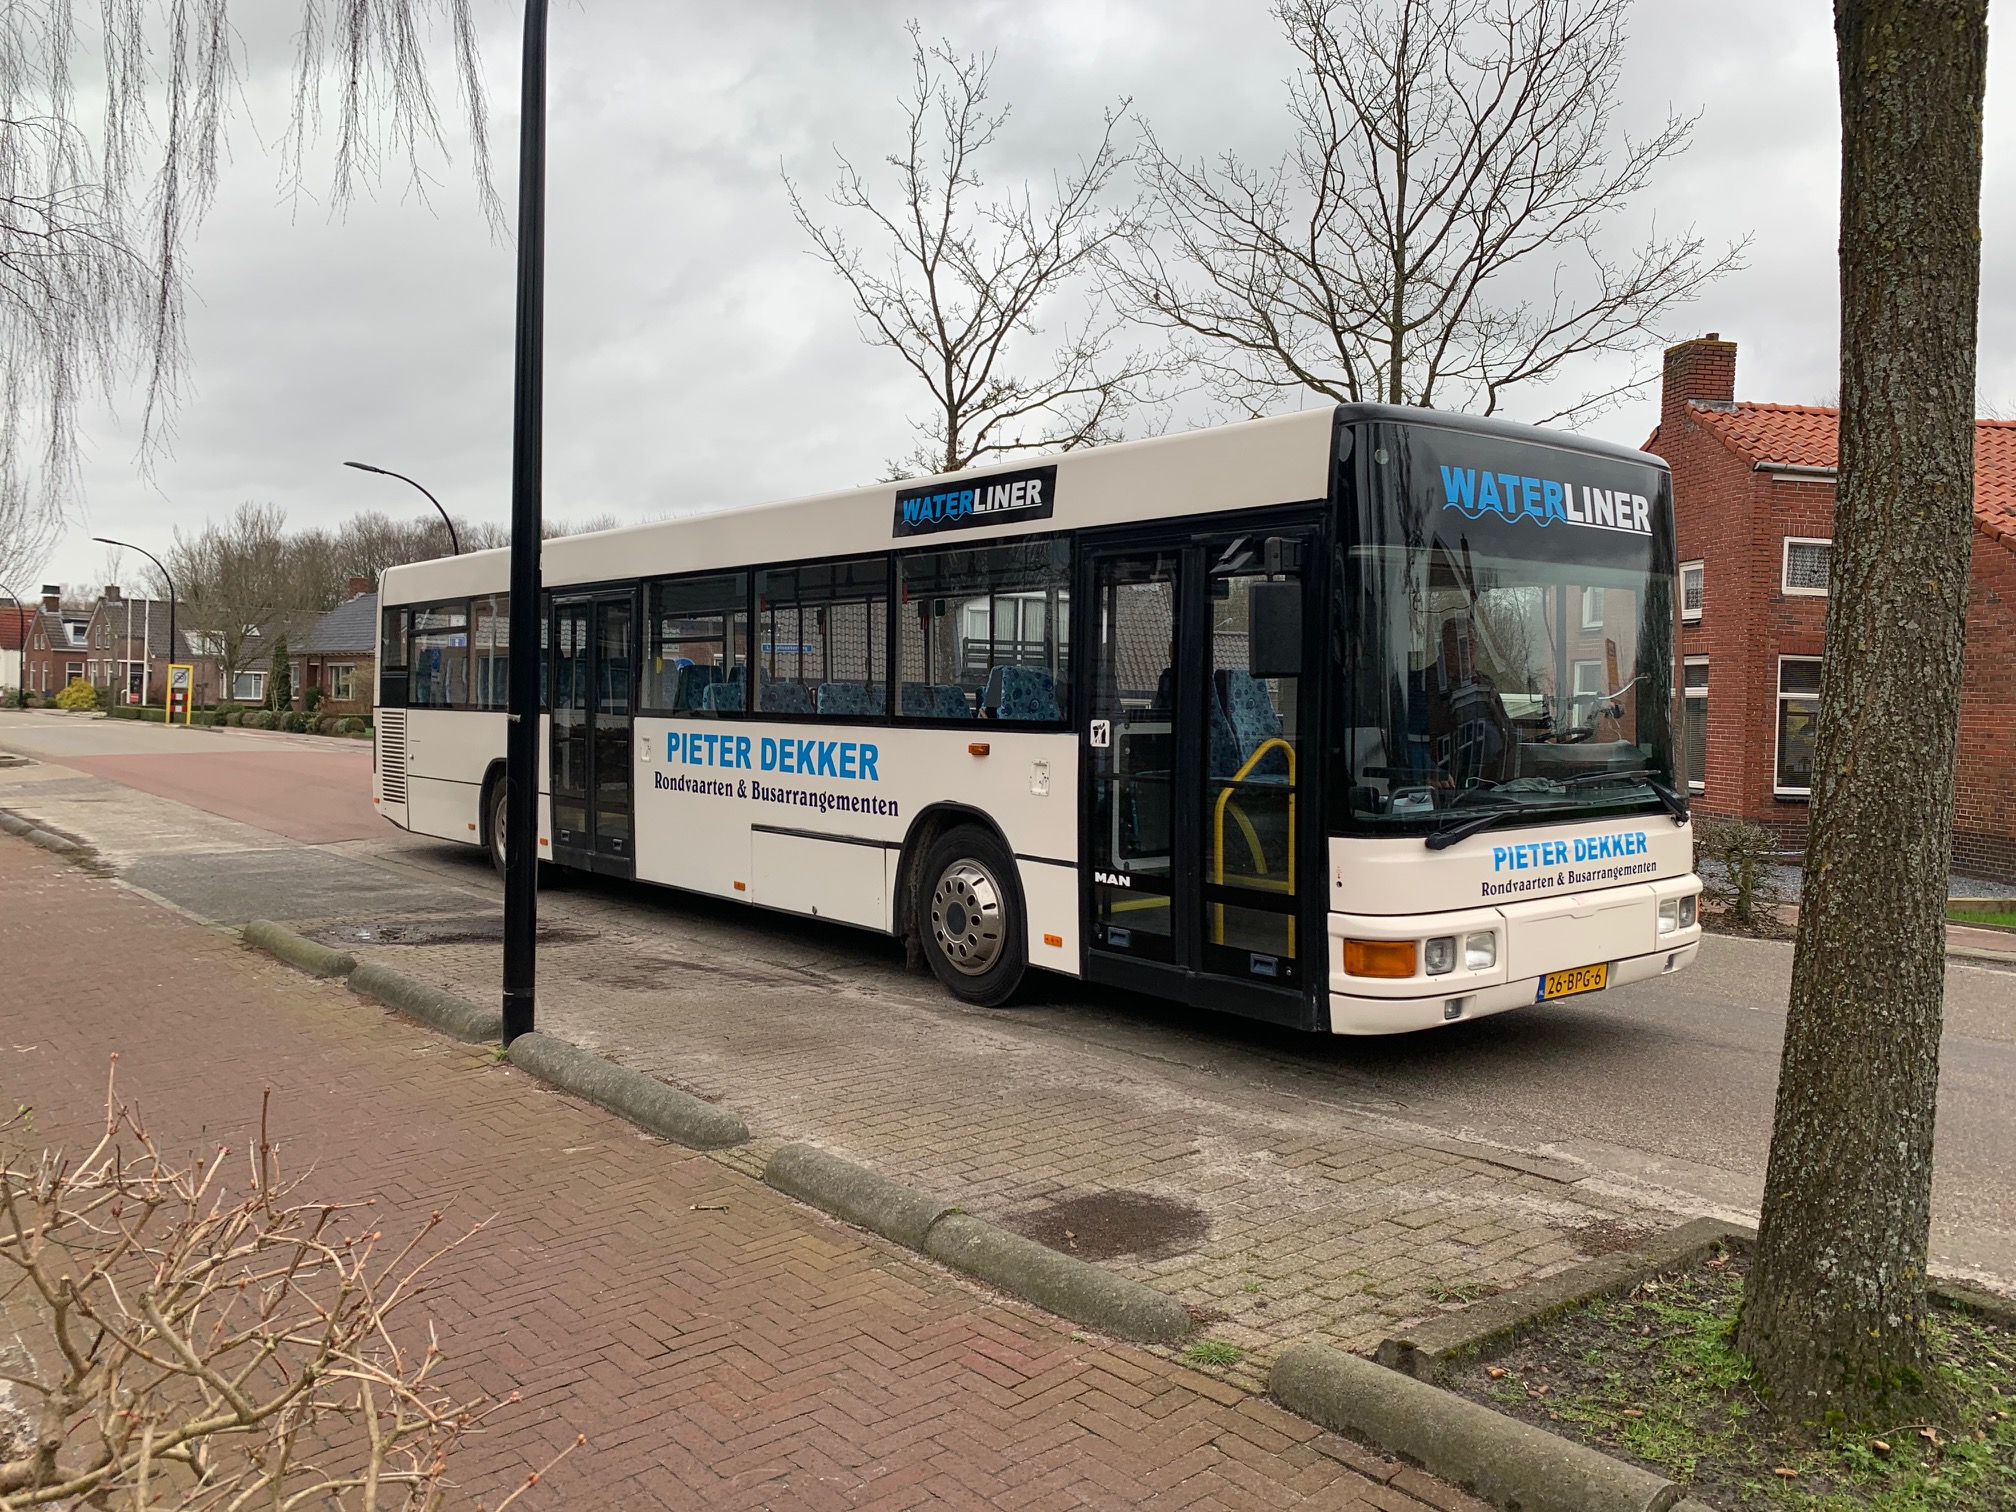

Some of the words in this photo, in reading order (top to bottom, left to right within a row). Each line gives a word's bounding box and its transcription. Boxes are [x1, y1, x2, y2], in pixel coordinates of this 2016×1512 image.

[903, 479, 1042, 521] WATERLINER
[1440, 465, 1651, 532] WATERLINER
[667, 732, 751, 769] PIETER
[760, 737, 879, 781] DEKKER
[654, 771, 733, 797] Rondvaarten
[736, 779, 747, 799] &
[751, 780, 899, 817] Busarrangementen
[1492, 840, 1568, 872] PIETER
[1573, 831, 1647, 863] DEKKER
[1094, 871, 1131, 887] MAN
[1481, 875, 1554, 896] Rondvaarten
[1557, 872, 1565, 886] &
[1568, 861, 1657, 884] Busarrangementen
[1548, 968, 1602, 994] 26-BPG-6
